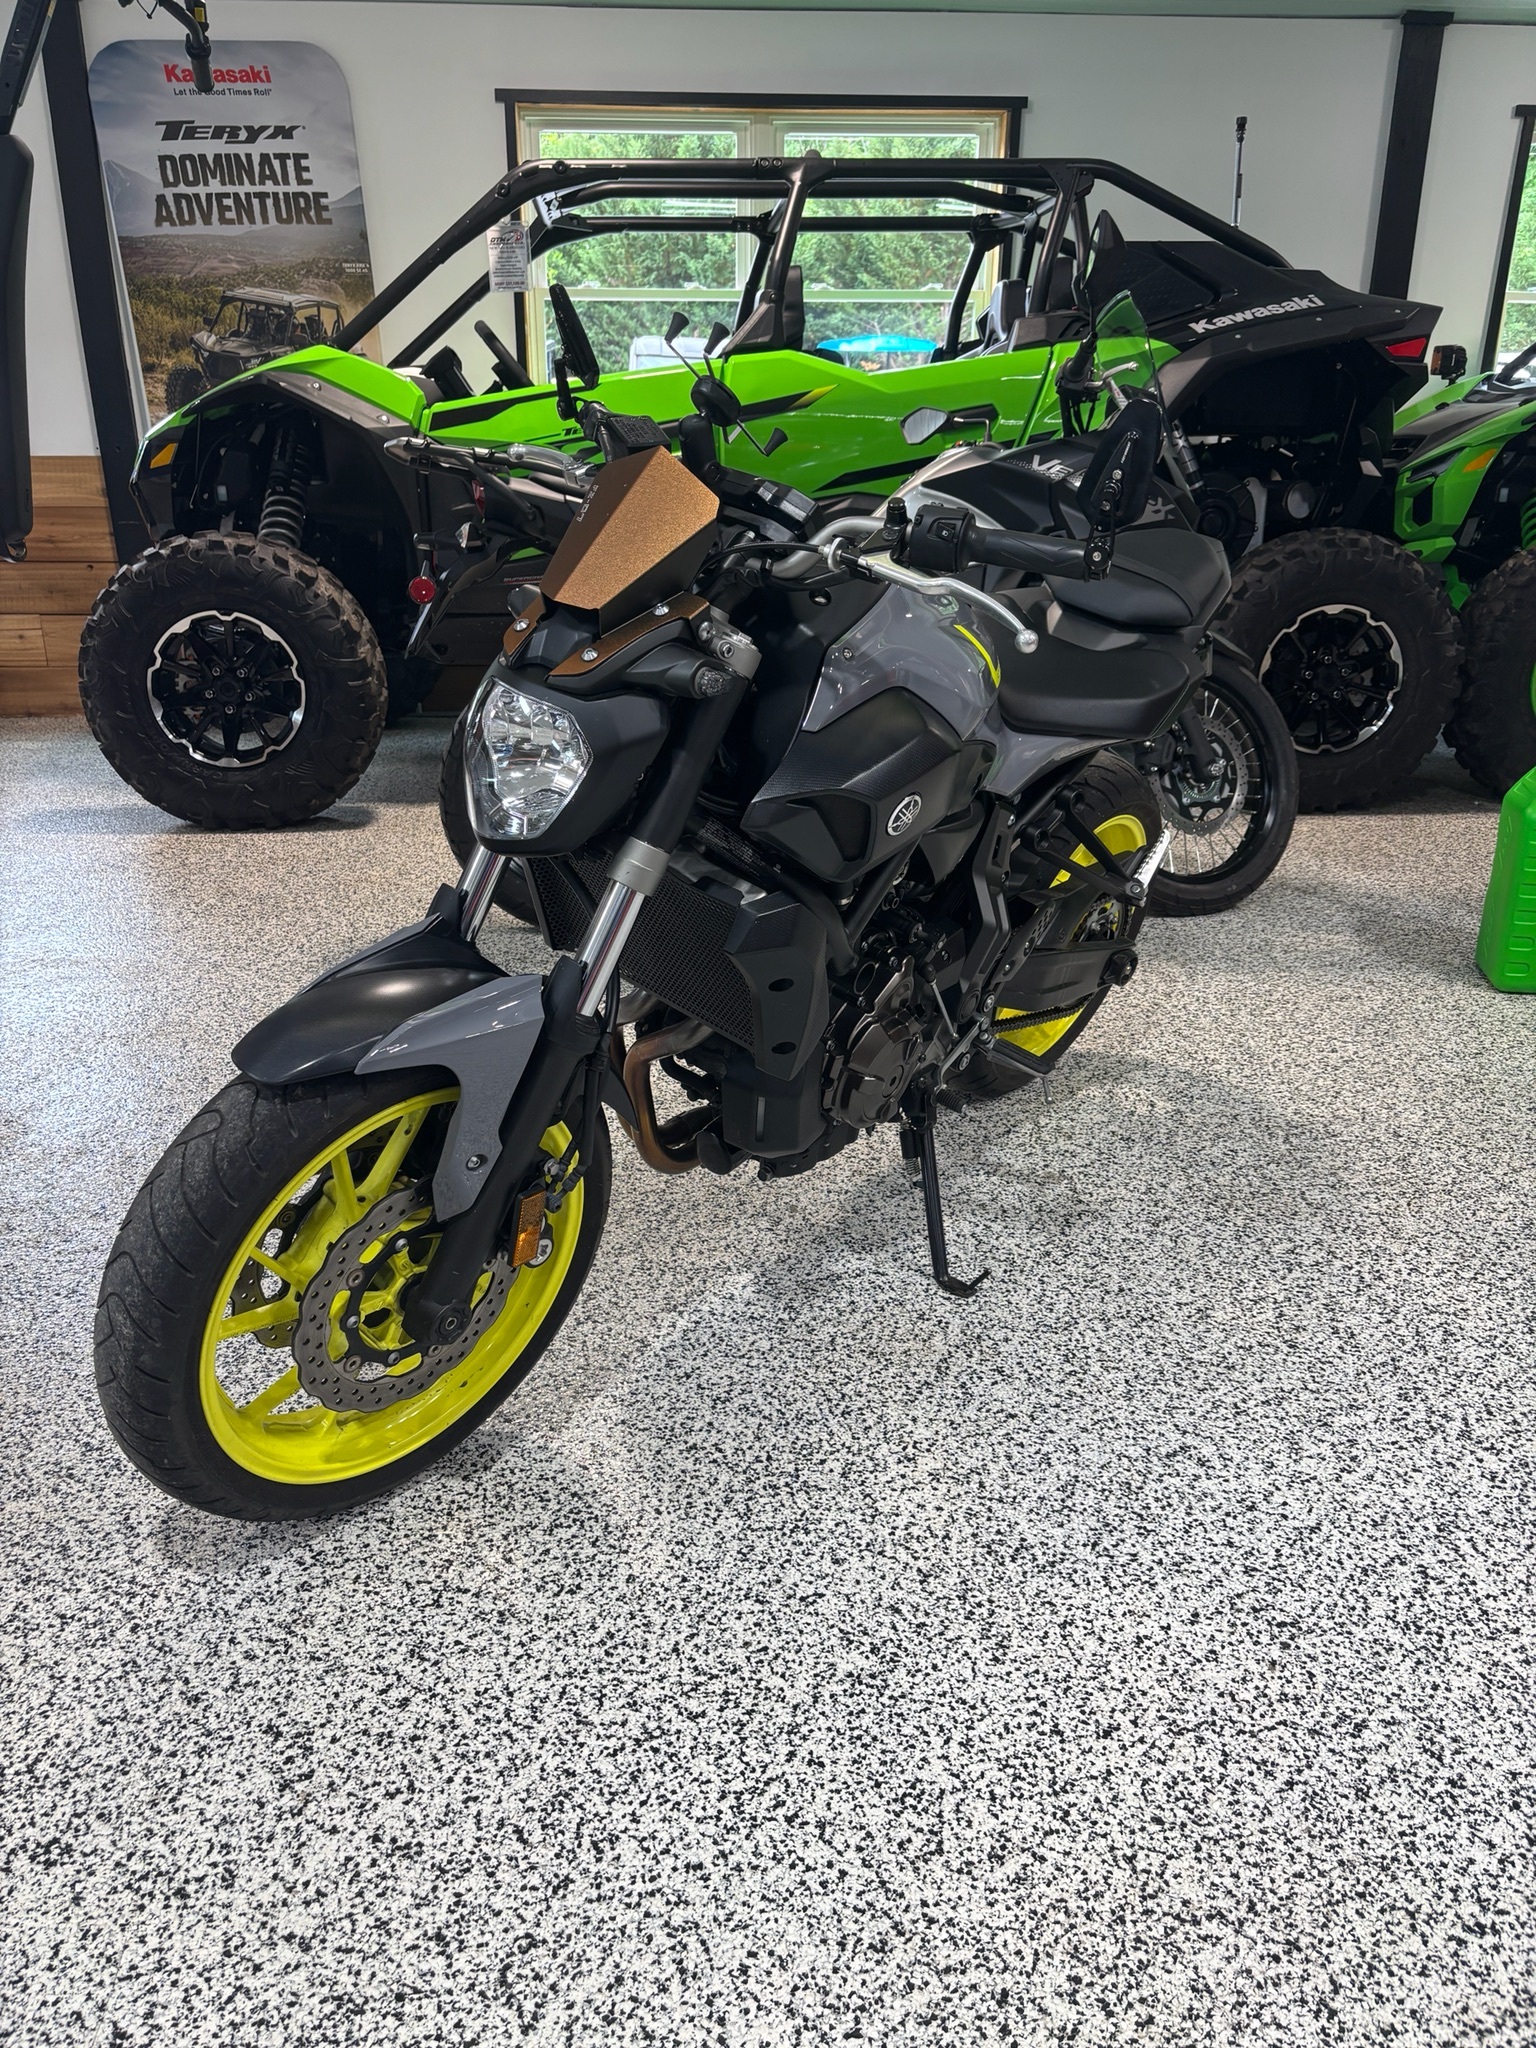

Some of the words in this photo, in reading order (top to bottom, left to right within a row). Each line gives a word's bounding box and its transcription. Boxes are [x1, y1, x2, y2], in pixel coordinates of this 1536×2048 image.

[163, 64, 272, 83] Kaasaki
[173, 88, 187, 96] Let
[226, 88, 252, 96] Times
[158, 153, 313, 188] DOMINATE
[155, 191, 333, 227] ADVENTURE
[1188, 294, 1326, 334] Kawasaki
